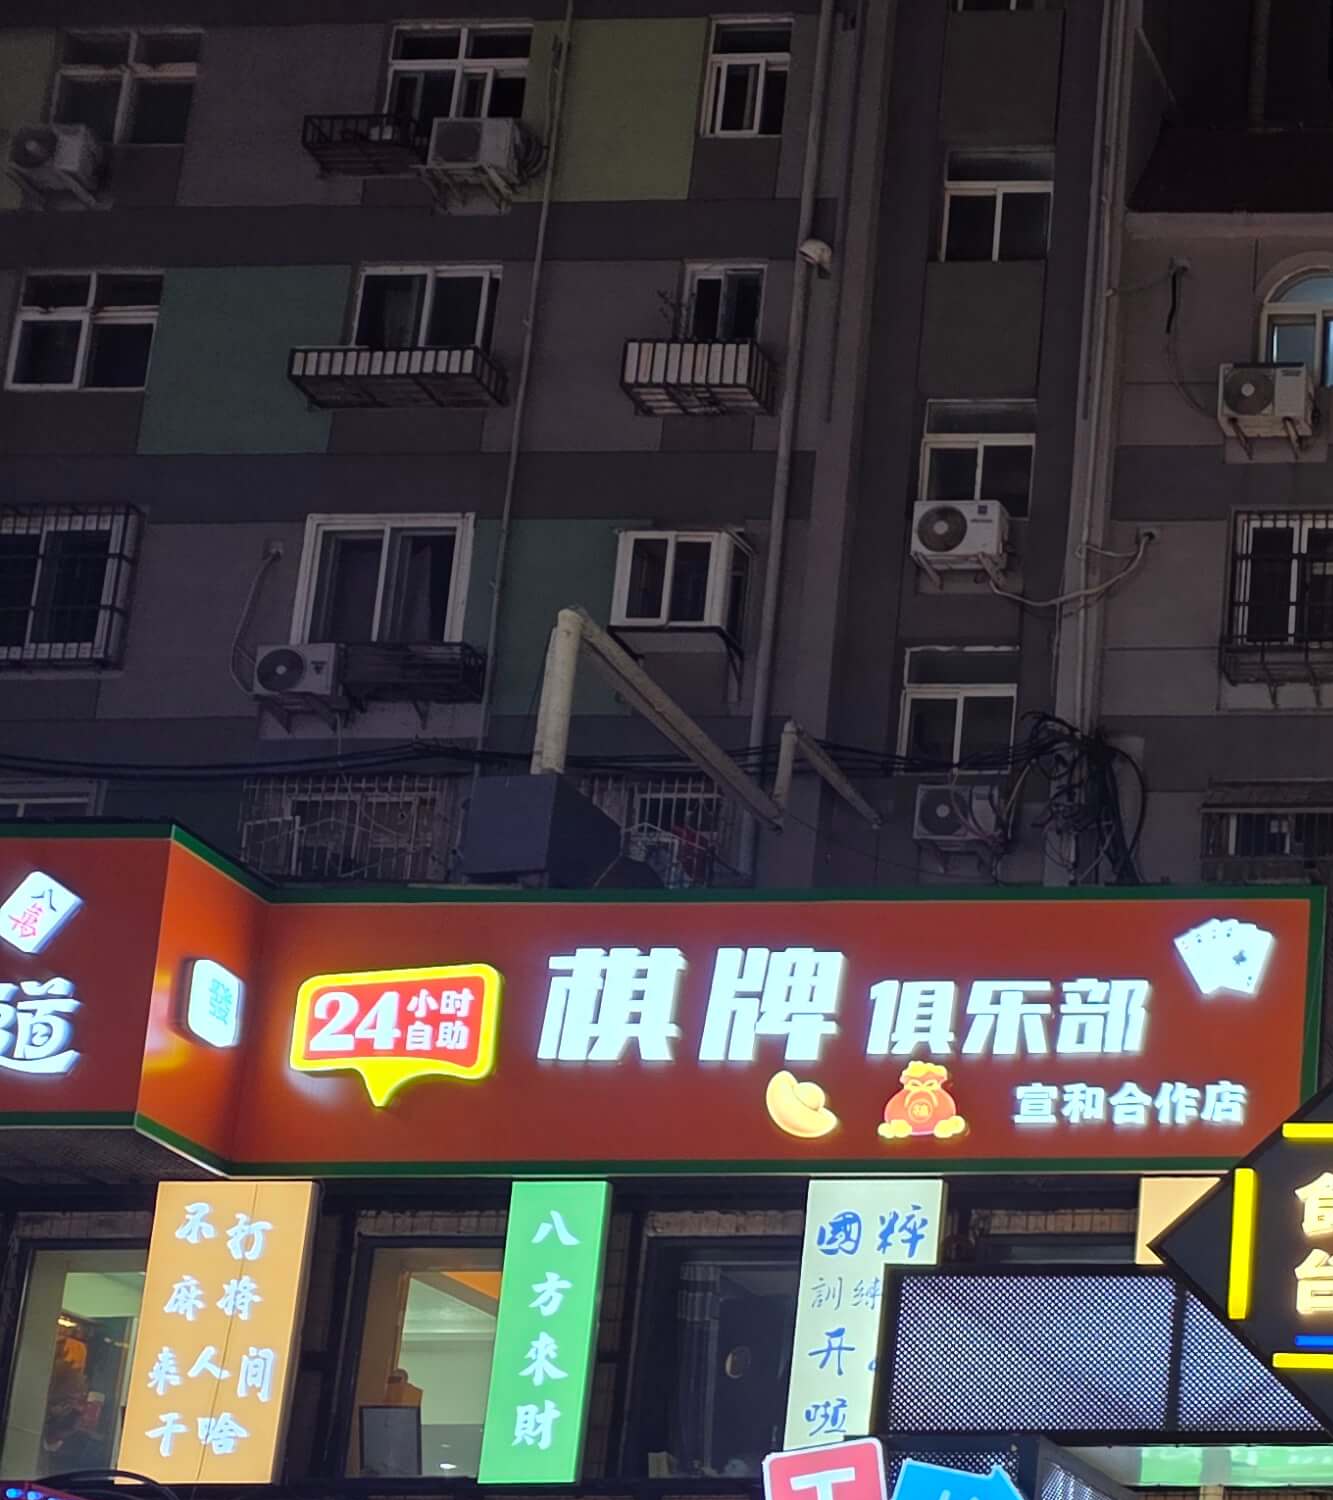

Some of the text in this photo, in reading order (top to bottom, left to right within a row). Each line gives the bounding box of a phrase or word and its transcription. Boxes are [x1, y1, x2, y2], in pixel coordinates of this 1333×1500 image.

[0, 976, 81, 1074] 道
[309, 990, 400, 1052] 24
[406, 989, 474, 1018] 小时
[538, 946, 1150, 1062] 棋牌 俱乐部
[406, 1021, 469, 1052] 自助
[1013, 1081, 1249, 1126] 宣和合作店
